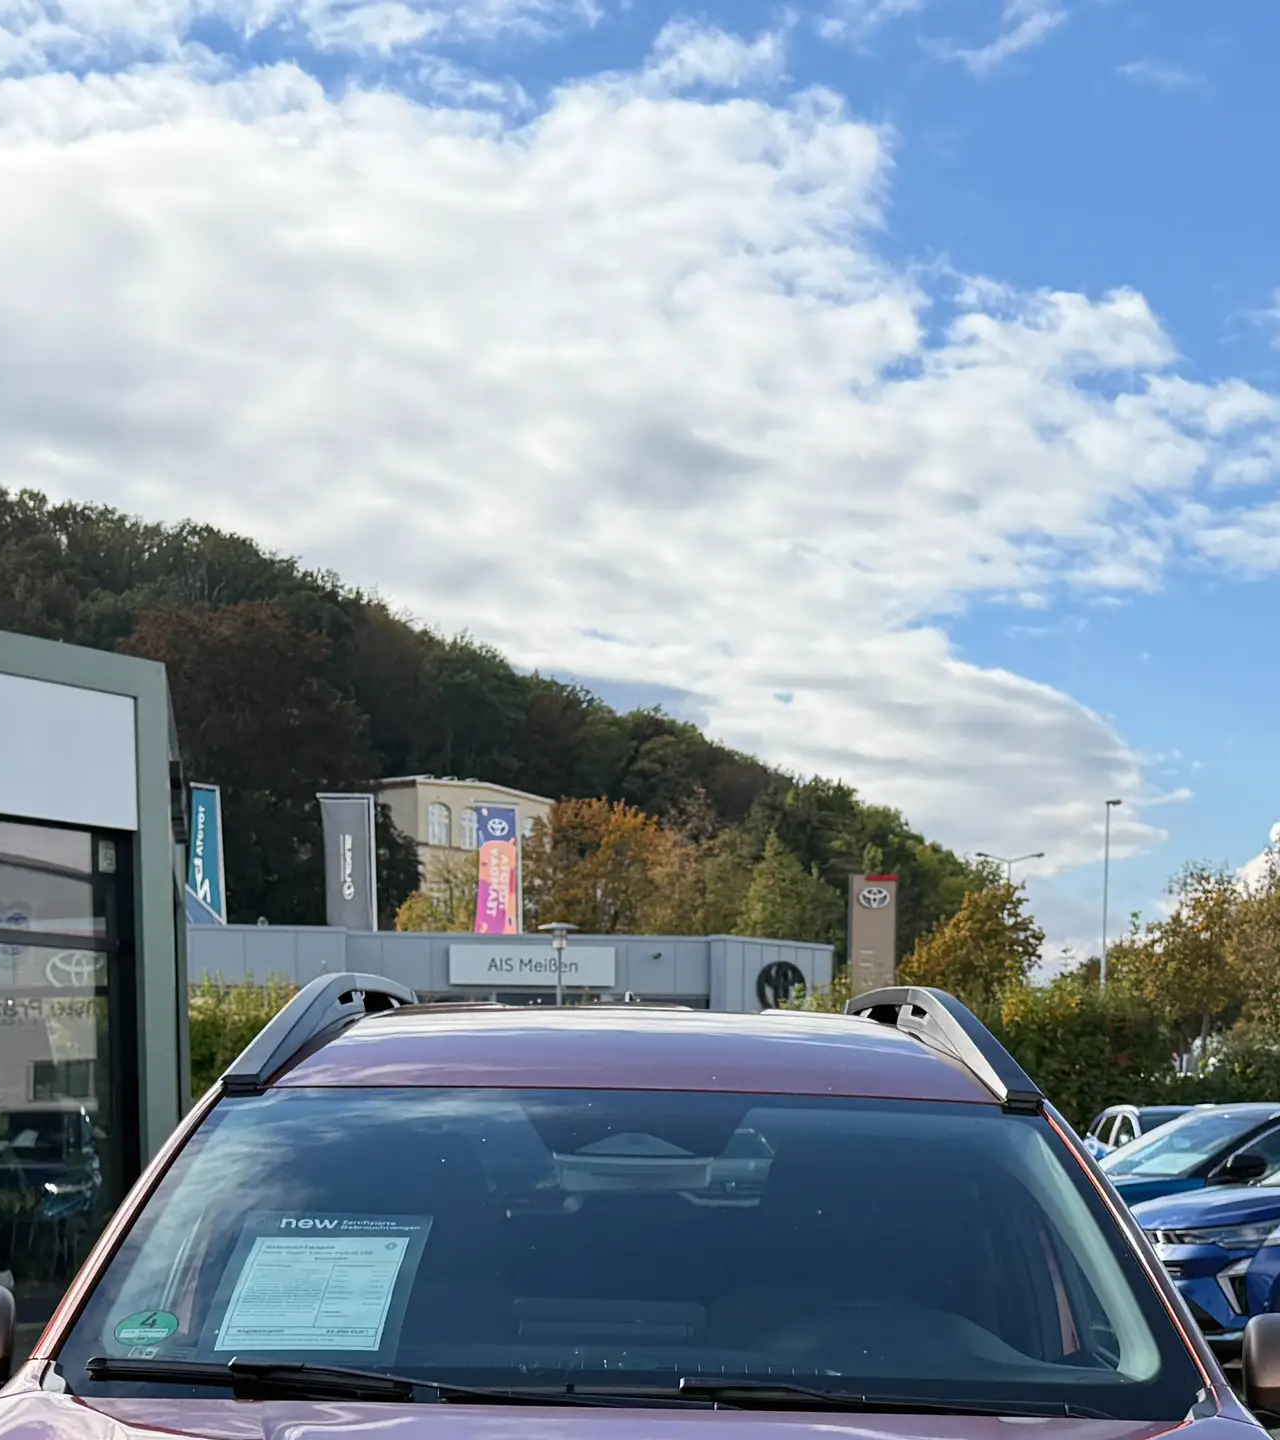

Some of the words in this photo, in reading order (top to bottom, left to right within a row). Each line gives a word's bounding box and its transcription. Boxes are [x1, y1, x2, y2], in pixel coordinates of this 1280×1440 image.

[487, 958, 514, 973] AIS
[519, 957, 579, 974] Meißen
[139, 1311, 159, 1329] 4
